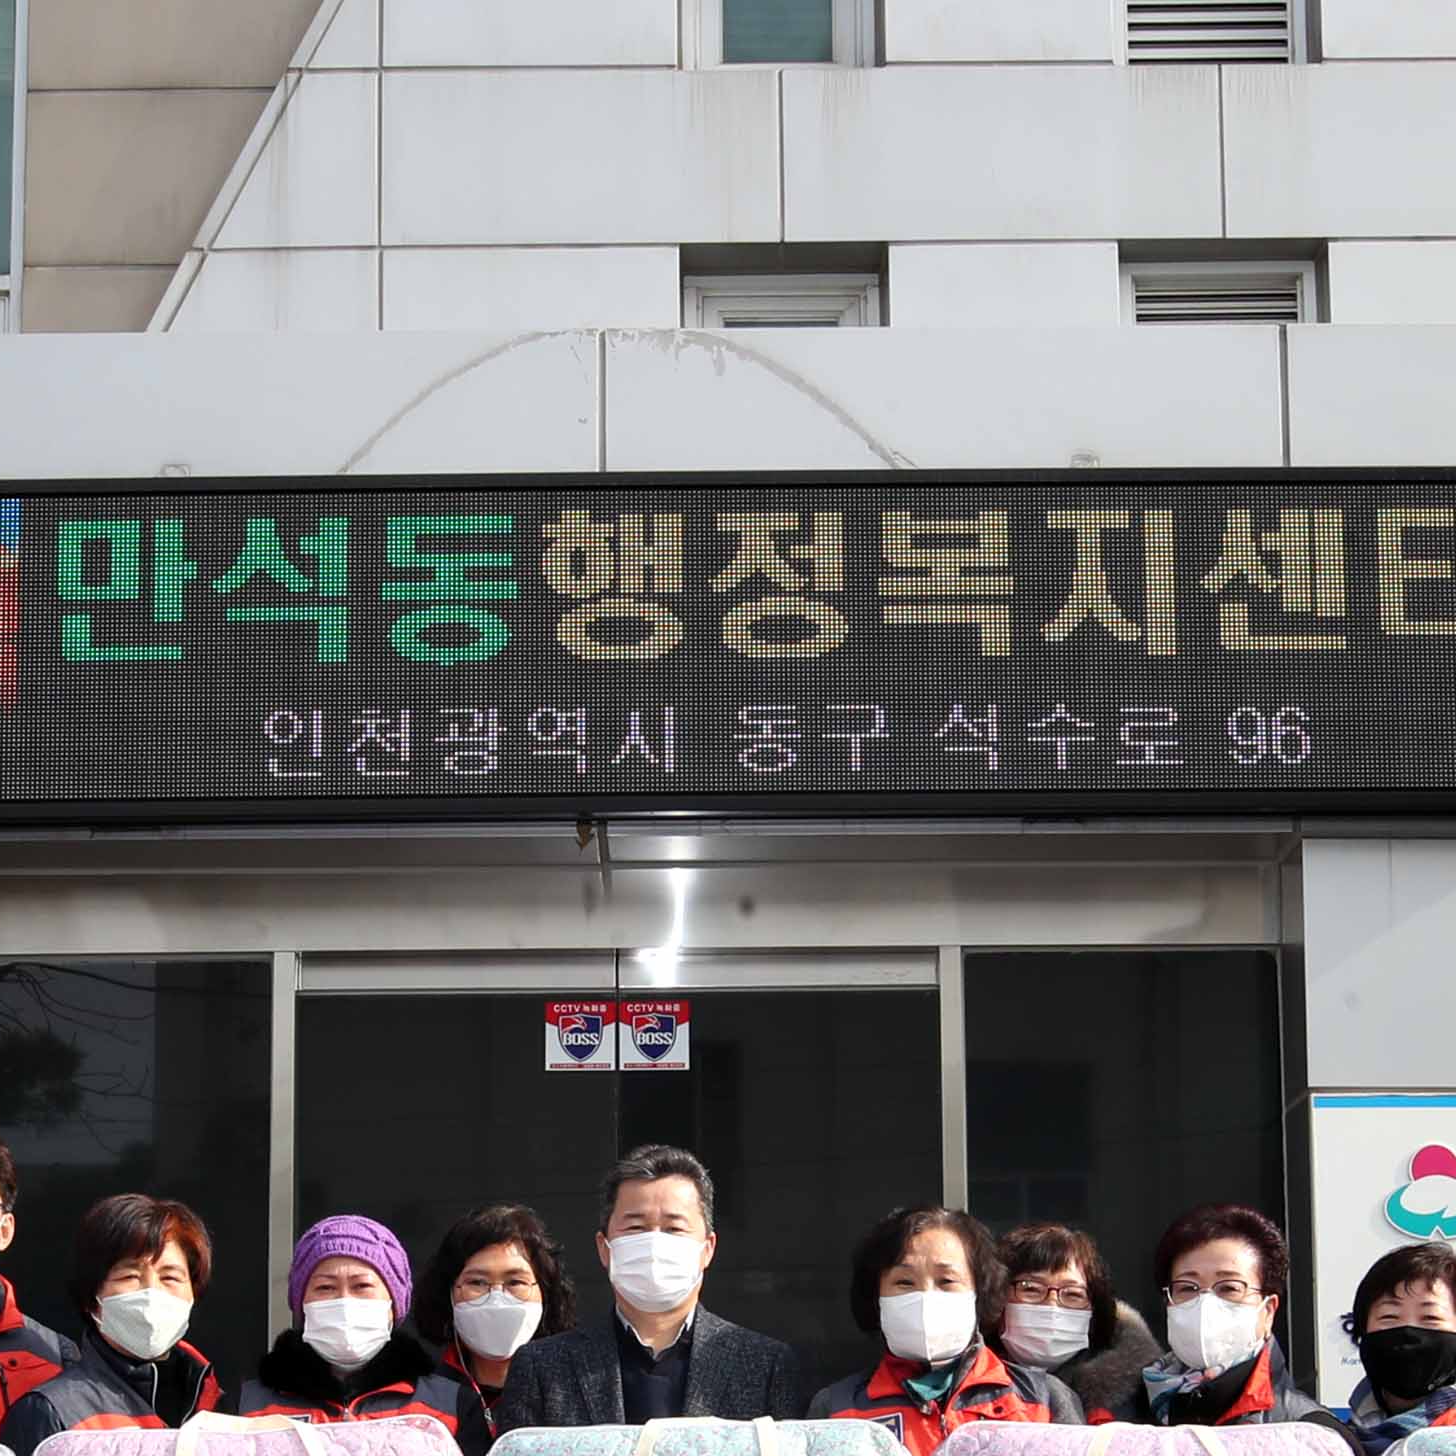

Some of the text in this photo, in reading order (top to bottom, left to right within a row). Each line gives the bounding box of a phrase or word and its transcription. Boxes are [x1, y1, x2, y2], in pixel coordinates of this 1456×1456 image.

[263, 703, 1311, 777] 인천광역시 동구 석수로 96
[553, 1004, 580, 1013] CCTV
[627, 1003, 654, 1012] CCTV
[563, 1032, 599, 1046] BOSS
[637, 1032, 673, 1045] BOSS
